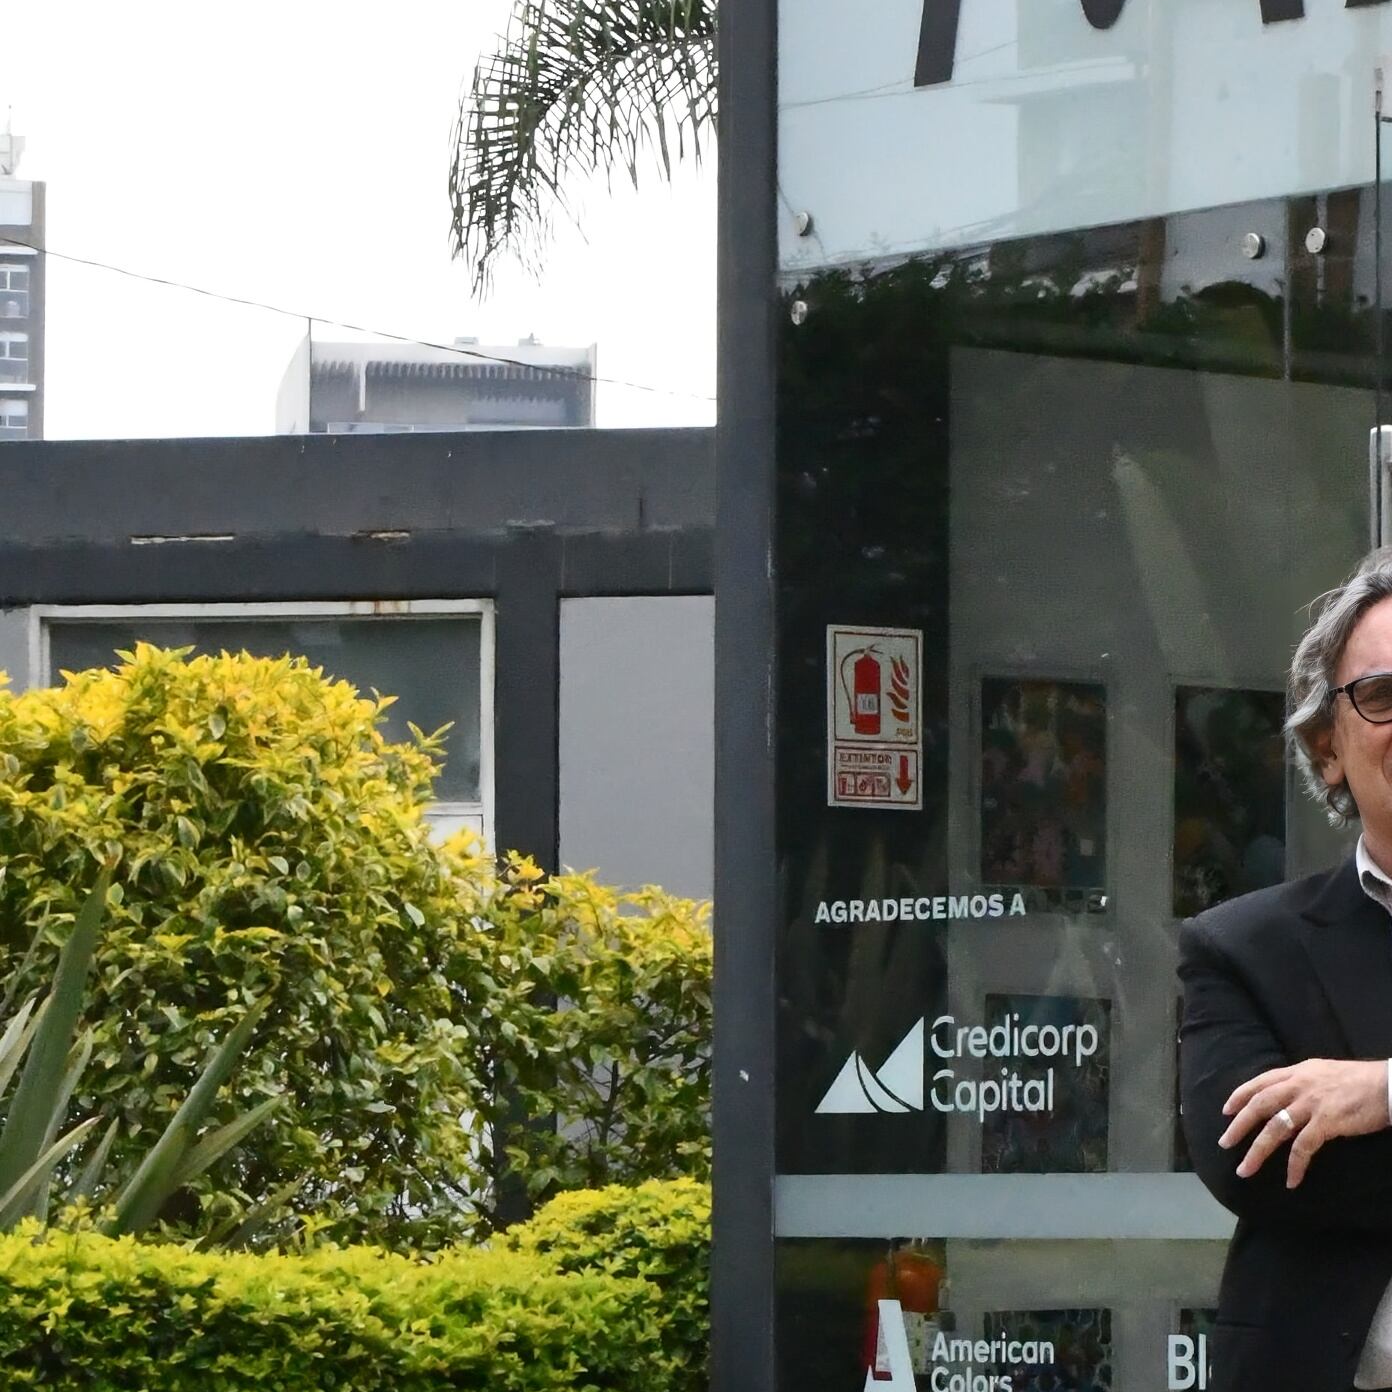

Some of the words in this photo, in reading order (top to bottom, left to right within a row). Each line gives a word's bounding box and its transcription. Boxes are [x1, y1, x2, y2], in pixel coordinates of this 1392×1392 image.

[814, 893, 1004, 923] AGRADECEMOS
[1009, 893, 1026, 917] A
[930, 1012, 1098, 1067] Credicorp
[930, 1067, 1054, 1124] Capital
[931, 1331, 1055, 1365] American
[1167, 1333, 1212, 1391] Bl
